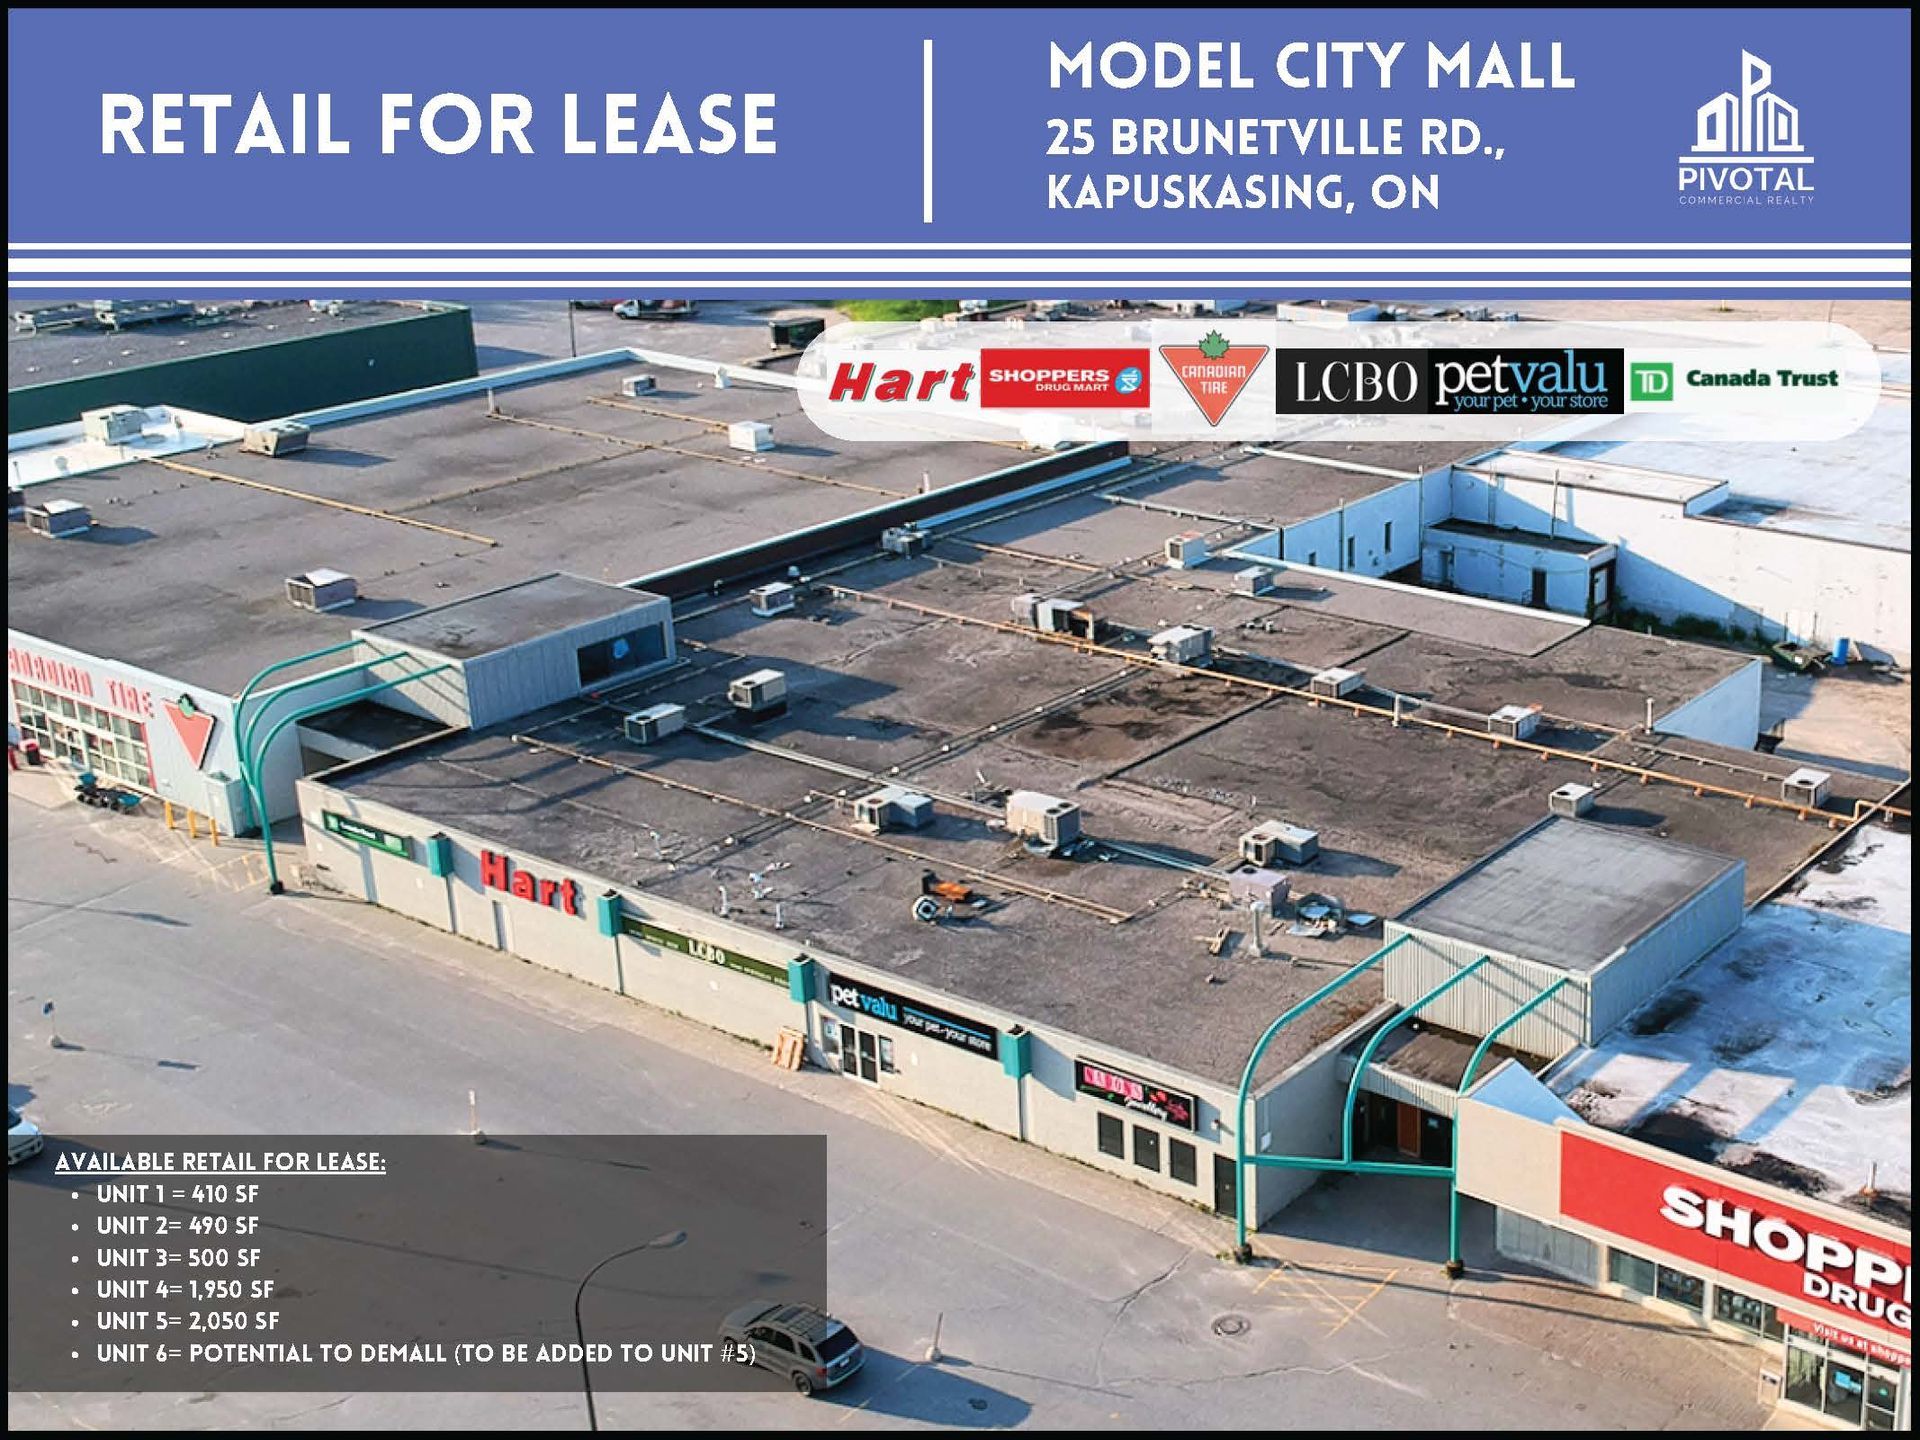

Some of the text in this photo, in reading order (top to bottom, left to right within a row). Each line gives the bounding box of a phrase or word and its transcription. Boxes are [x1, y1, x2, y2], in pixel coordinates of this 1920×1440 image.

[480, 849, 579, 916] Hart
[688, 938, 726, 966] LCBO
[1660, 1185, 1911, 1302] SHOPP
[1803, 1272, 1911, 1329] DRUG
